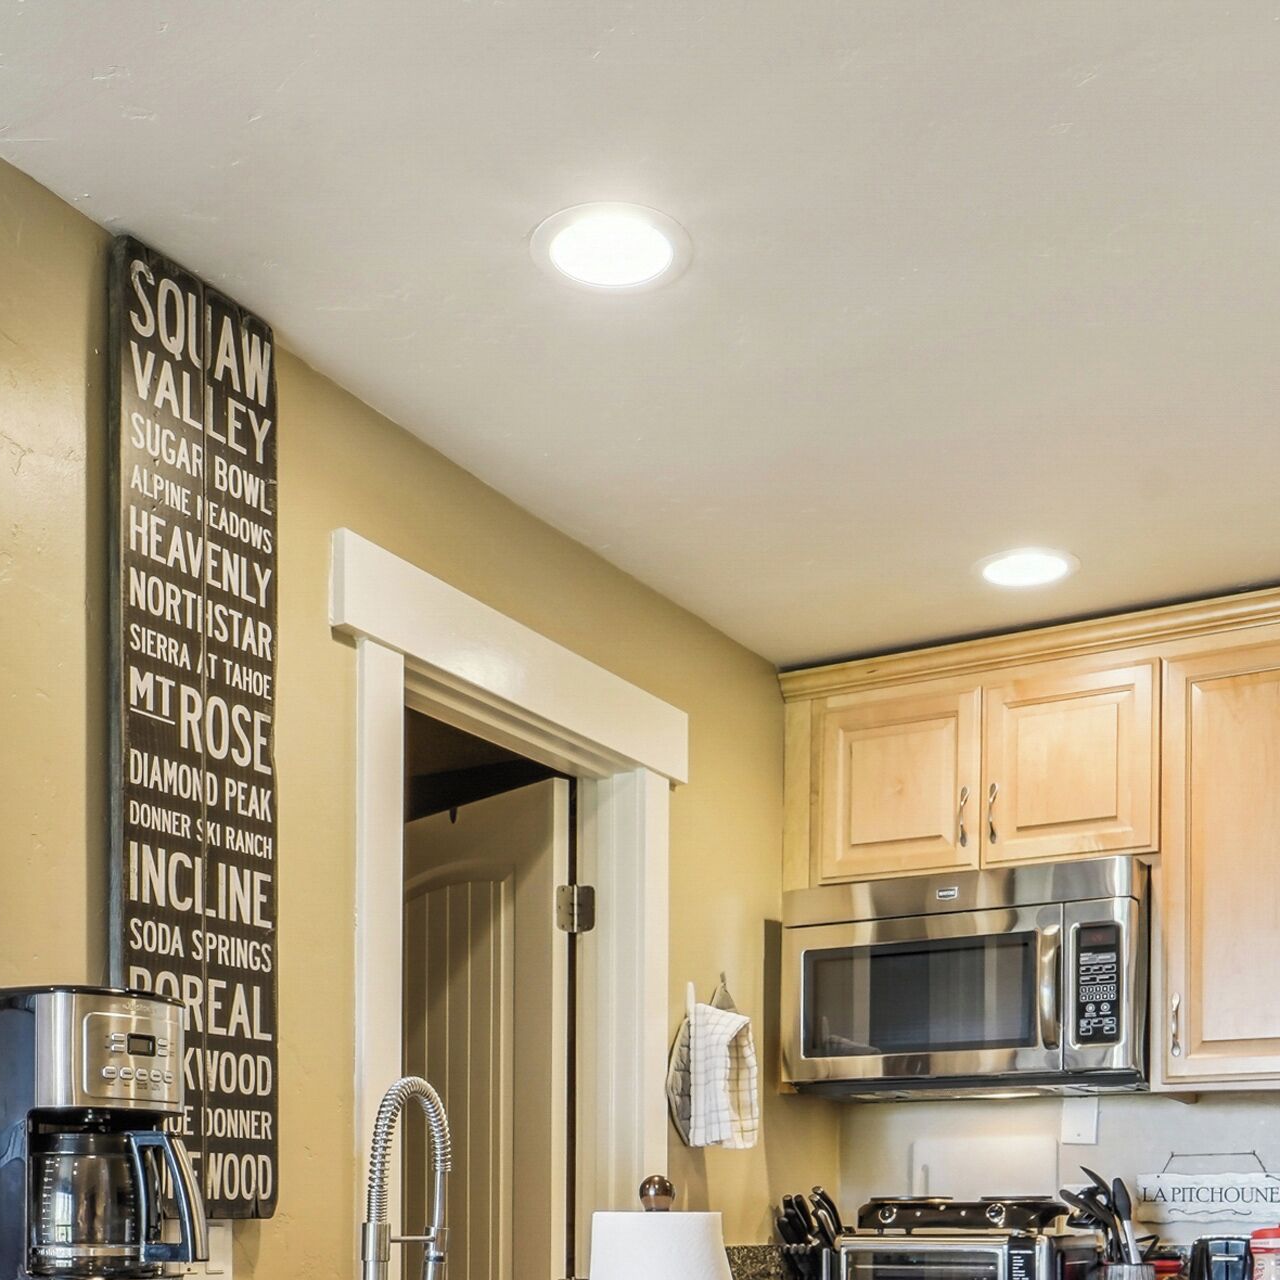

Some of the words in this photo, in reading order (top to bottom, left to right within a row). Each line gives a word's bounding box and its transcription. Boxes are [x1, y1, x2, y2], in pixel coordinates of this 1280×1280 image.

[129, 259, 272, 408] SQUAW
[129, 340, 272, 464] VALLEY
[130, 411, 203, 479] SUGAR
[214, 455, 272, 516] BOWL
[130, 464, 191, 516] ALPINE
[196, 495, 272, 554] MEADOWS
[129, 505, 272, 608] HEAVENLY
[129, 566, 272, 662] NORTHSTAR
[129, 622, 192, 671] SIERRA
[196, 650, 218, 680] AT
[222, 658, 272, 701] TAHOE
[129, 665, 176, 720] MT
[179, 683, 272, 776] ROSE
[129, 747, 218, 807] DIAMOND
[224, 777, 272, 824] PEAK
[129, 799, 192, 840] DONNER
[196, 818, 221, 847] SKI
[225, 825, 272, 860] RANCH
[129, 840, 272, 930] INCLINE
[129, 917, 185, 958] SODA
[191, 929, 272, 974] SPRINGS
[183, 1047, 273, 1097] KWOOD
[200, 1106, 273, 1141] DONNER
[1142, 1186, 1168, 1203] LA
[1171, 1186, 1280, 1204] PITCHOUNE
